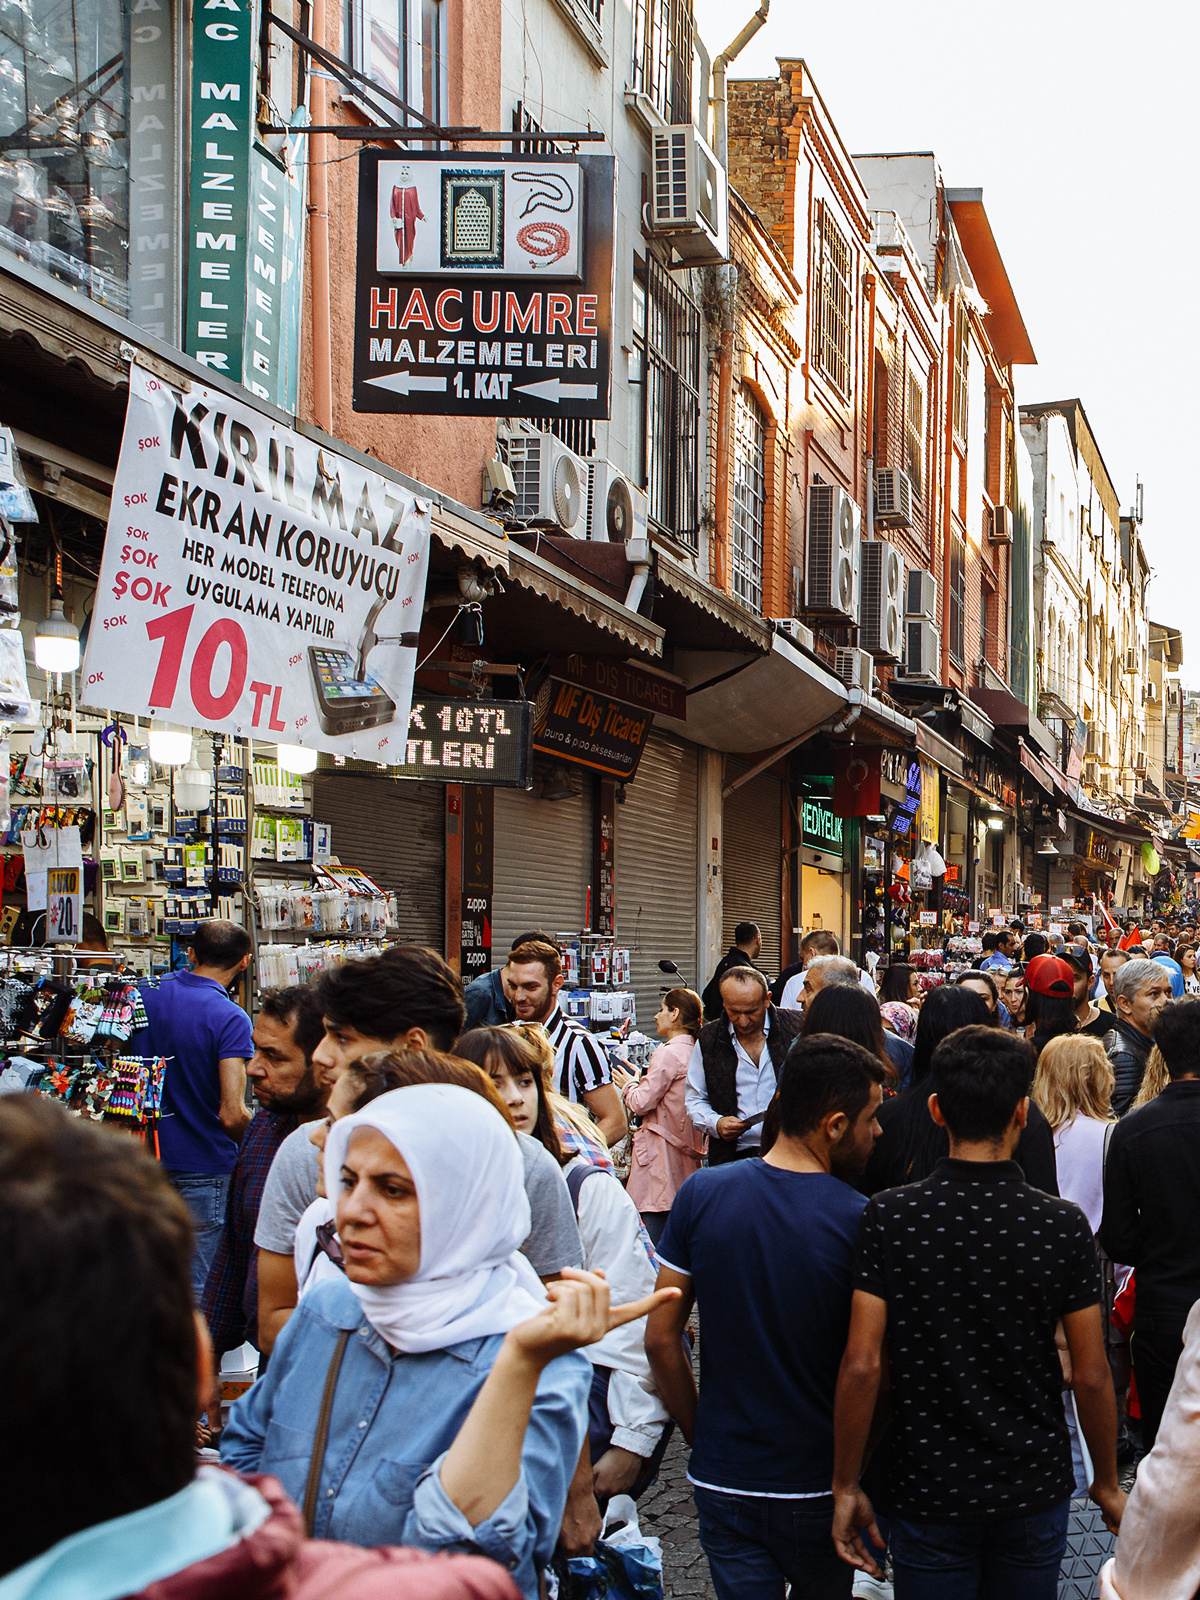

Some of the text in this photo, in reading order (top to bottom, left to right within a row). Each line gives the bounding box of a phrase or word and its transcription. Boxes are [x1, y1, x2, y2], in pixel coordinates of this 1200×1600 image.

[195, 82, 241, 370] MALZEMELER
[369, 286, 598, 337] HAC UMRE
[369, 337, 598, 369] MALZEMELERİ
[453, 371, 513, 400] 1. KAT
[138, 436, 161, 451] ŞOK
[170, 390, 406, 556] KIRILMAZ
[123, 493, 149, 507] ŞOK
[126, 526, 150, 541] ŞOK
[155, 472, 401, 601] EKRAN KORUYUCU
[120, 545, 159, 569] ŞOK
[407, 552, 419, 565] ŞOK
[112, 571, 172, 607] ŞOK
[182, 537, 344, 613] HER MODEL TELEFONA
[103, 615, 128, 630] ŞOK
[185, 574, 335, 639] UYGULAMA YAPILIR
[145, 603, 286, 732] 10 TL
[289, 652, 303, 667] ŞOK
[596, 661, 619, 695] DIŞ
[624, 671, 676, 709] TİCARET
[295, 715, 308, 730] ŞOK
[553, 683, 647, 745] MF Dış Ticaret
[544, 728, 564, 742] puro
[58, 896, 73, 936] 20
